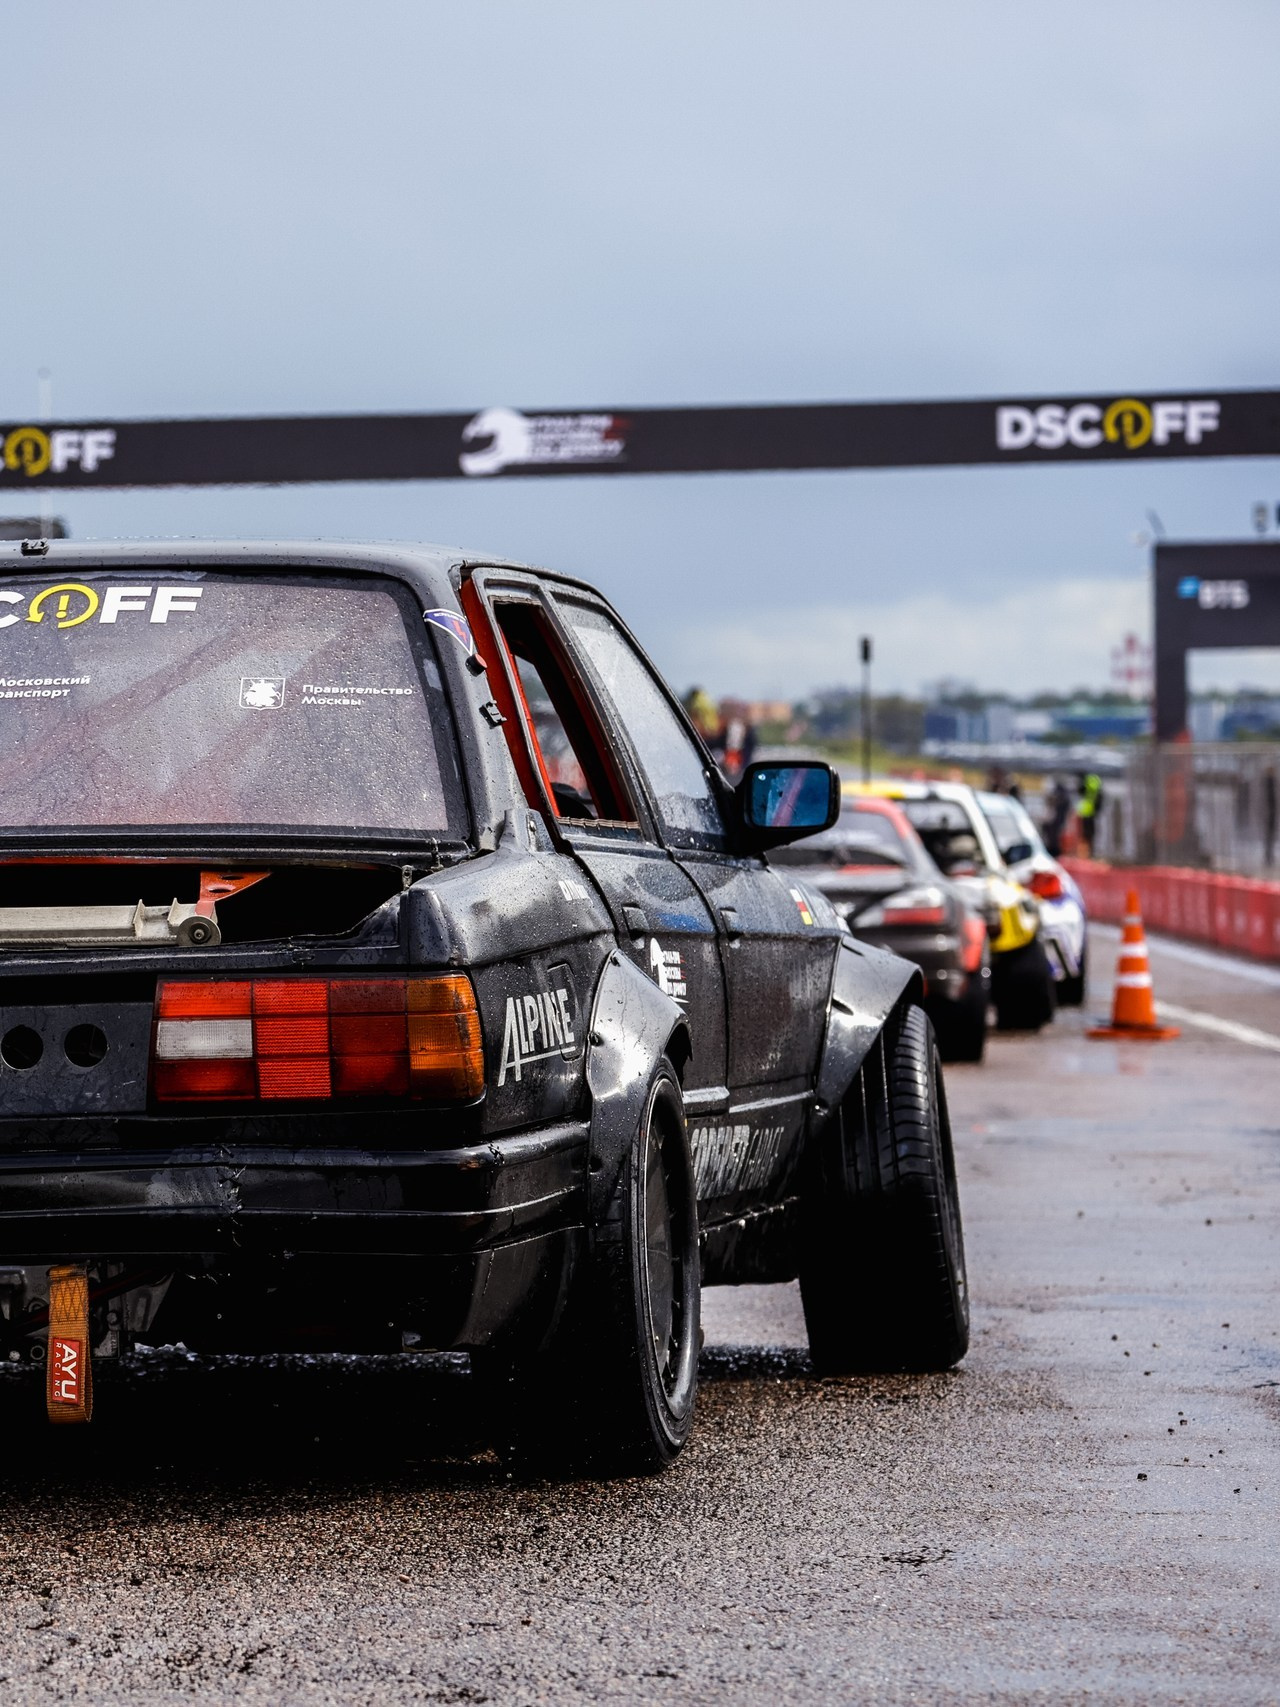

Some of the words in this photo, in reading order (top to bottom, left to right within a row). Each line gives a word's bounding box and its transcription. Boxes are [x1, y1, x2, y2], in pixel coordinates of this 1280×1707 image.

[301, 696, 362, 706] Москвы
[302, 684, 413, 696] Правительство
[498, 988, 576, 1087] ALPINE
[61, 1344, 77, 1399] AYU
